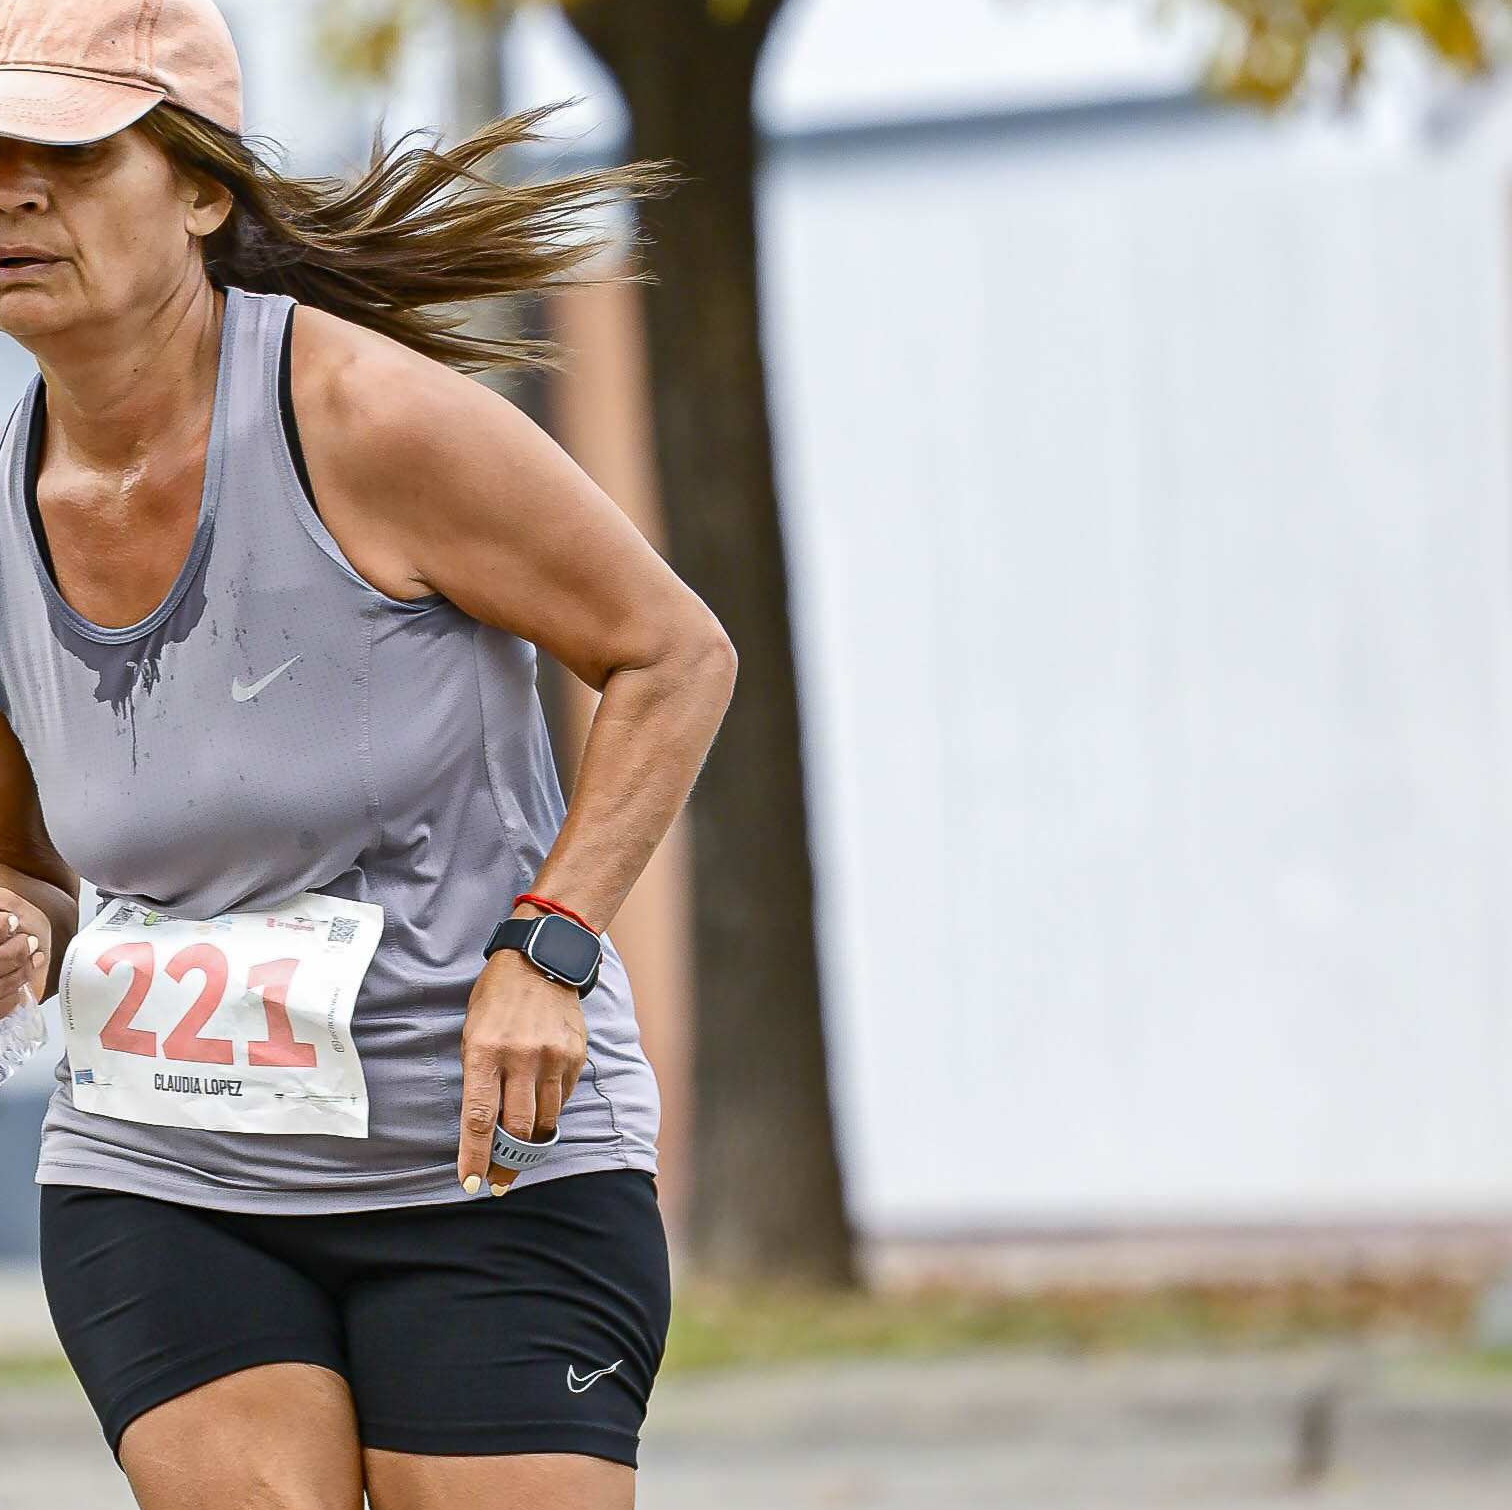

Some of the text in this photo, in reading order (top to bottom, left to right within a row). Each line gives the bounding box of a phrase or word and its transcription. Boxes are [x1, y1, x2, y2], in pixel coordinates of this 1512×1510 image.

[96, 941, 317, 1068] 221
[154, 1073, 243, 1097] CLAUDIA LOPEZ
